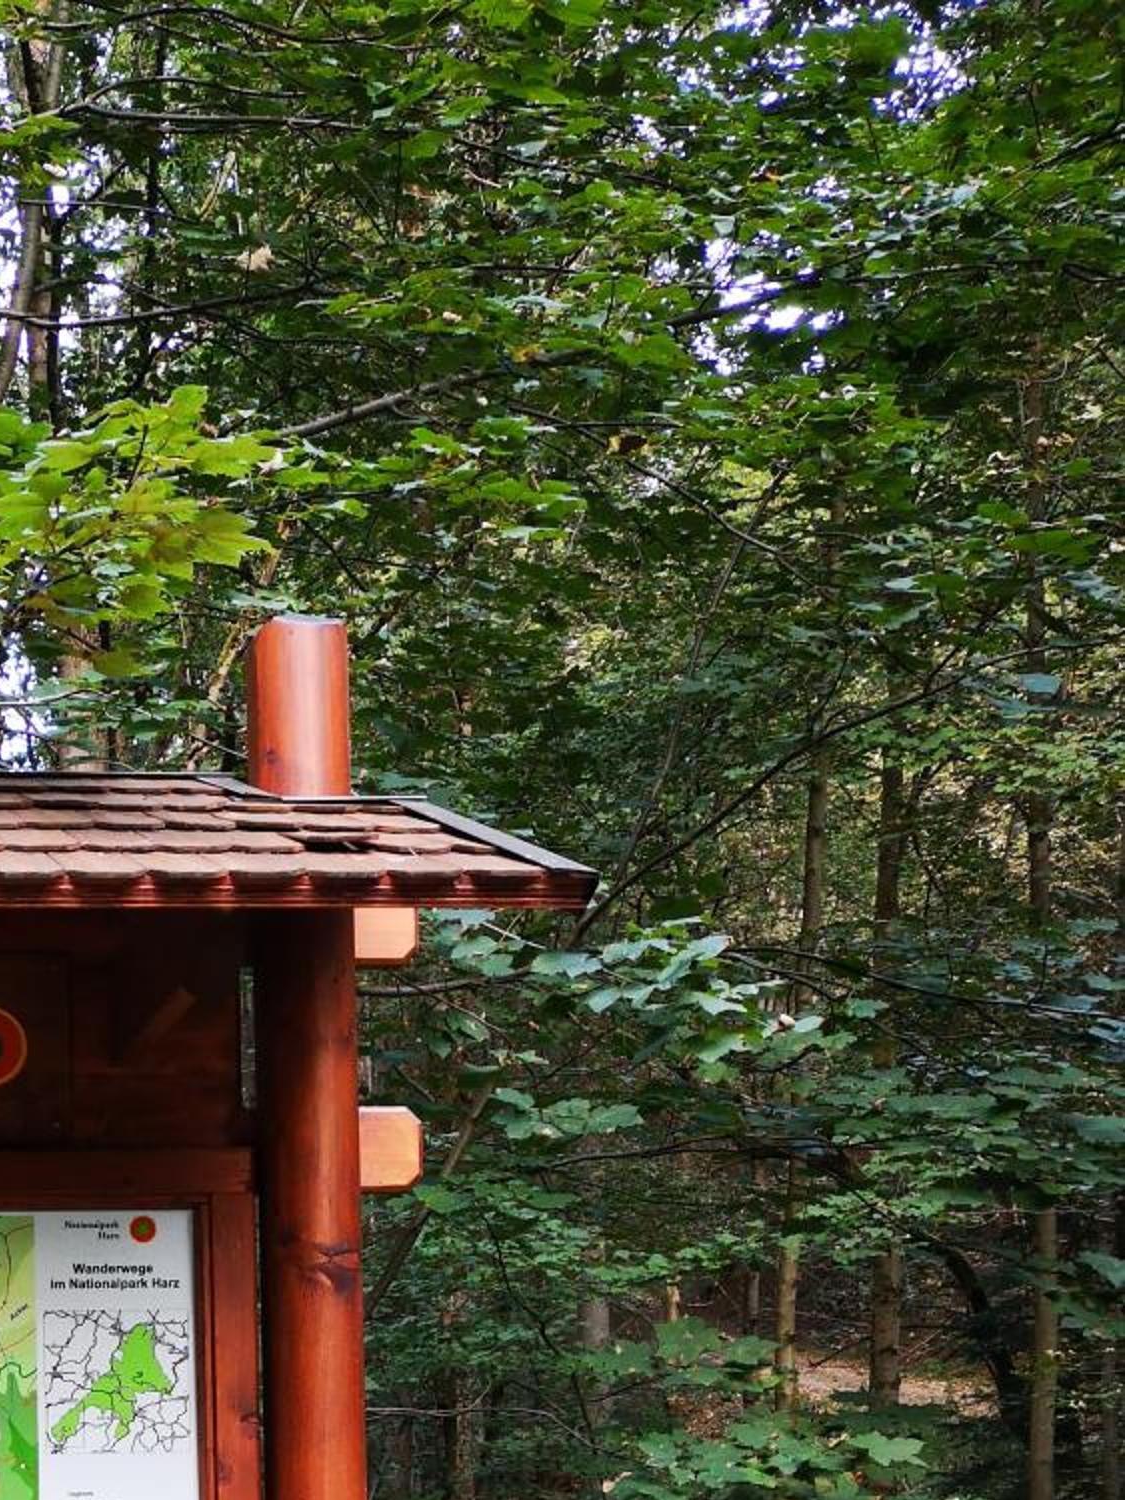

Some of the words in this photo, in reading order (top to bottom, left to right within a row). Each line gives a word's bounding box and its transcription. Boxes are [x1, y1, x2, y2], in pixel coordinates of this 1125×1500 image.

[72, 1263, 154, 1275] Wanderwege
[68, 1278, 148, 1290] Nationalpark
[151, 1278, 180, 1289] Harz
